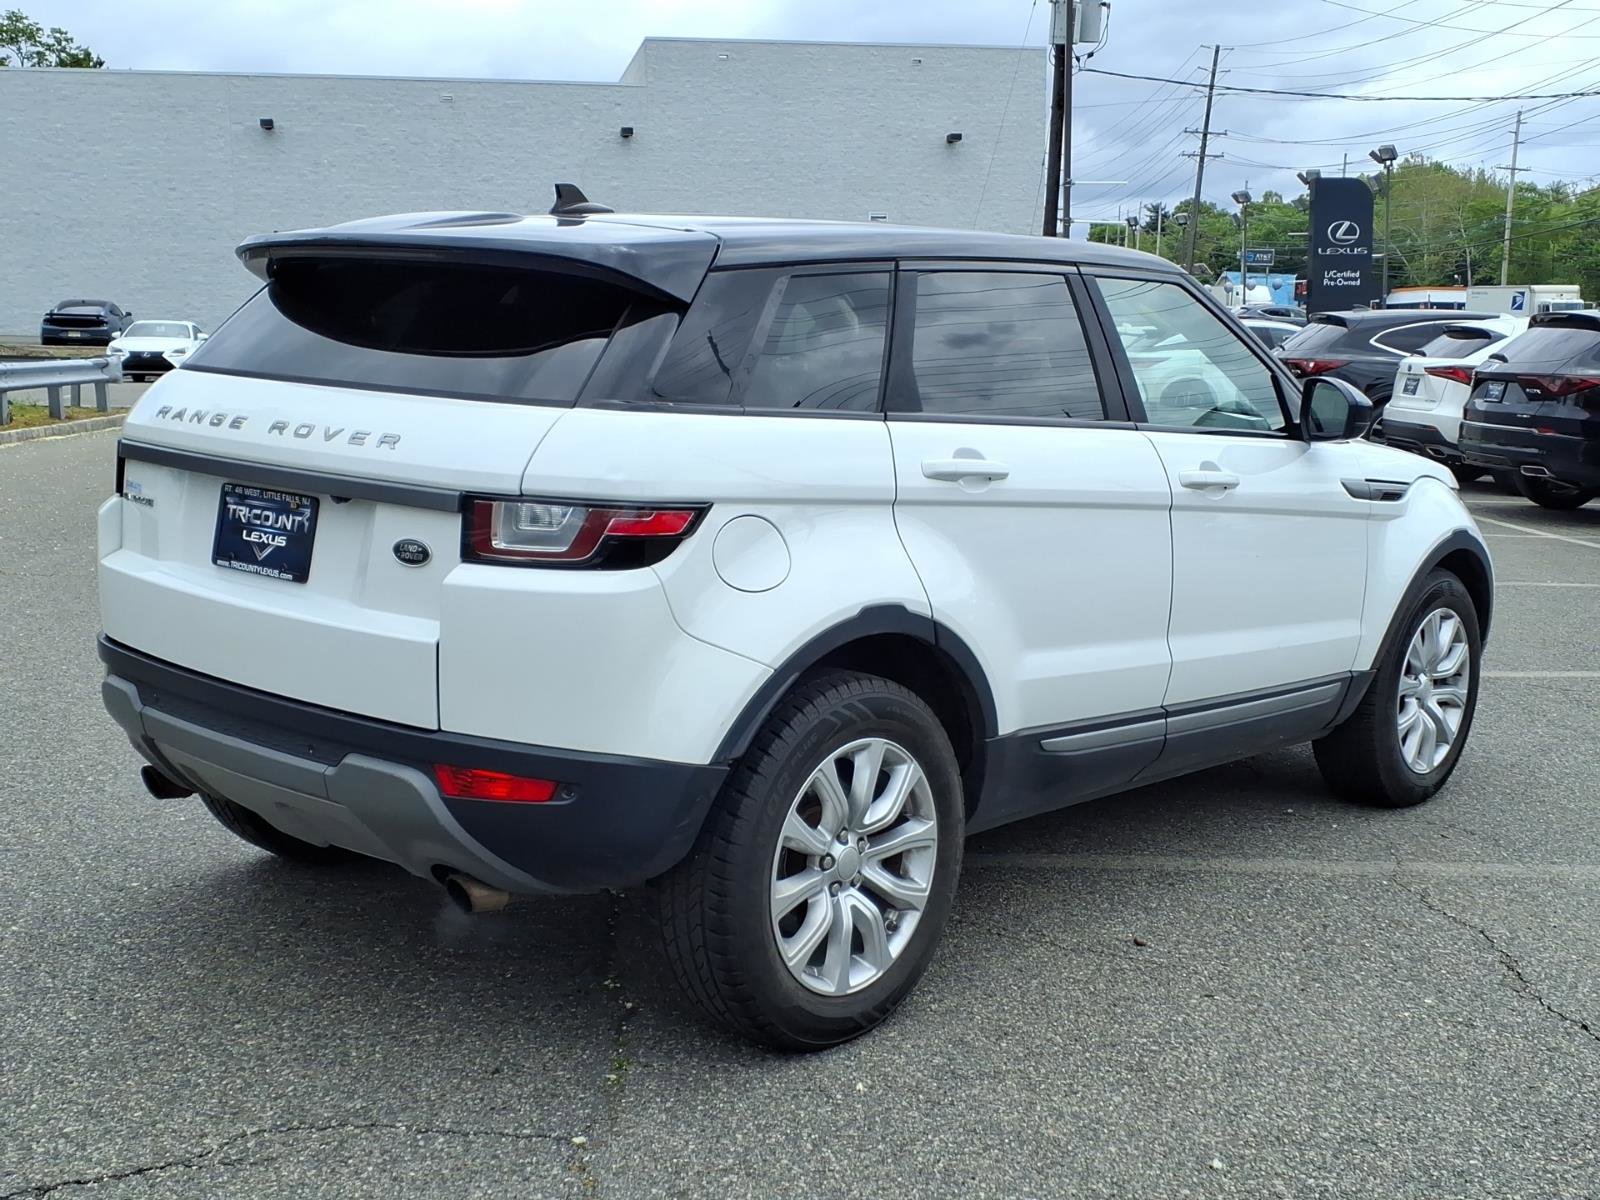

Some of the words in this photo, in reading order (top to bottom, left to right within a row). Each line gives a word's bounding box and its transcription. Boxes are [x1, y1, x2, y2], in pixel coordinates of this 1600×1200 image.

[1318, 247, 1368, 255] LEXUS
[1324, 270, 1360, 279] L/Certified
[1323, 278, 1361, 287] Pre-Owned
[155, 405, 249, 430] RANGE
[268, 419, 402, 450] ROVER
[263, 491, 281, 501] LITTLE
[302, 497, 311, 506] NJ
[242, 529, 287, 547] LEXUS
